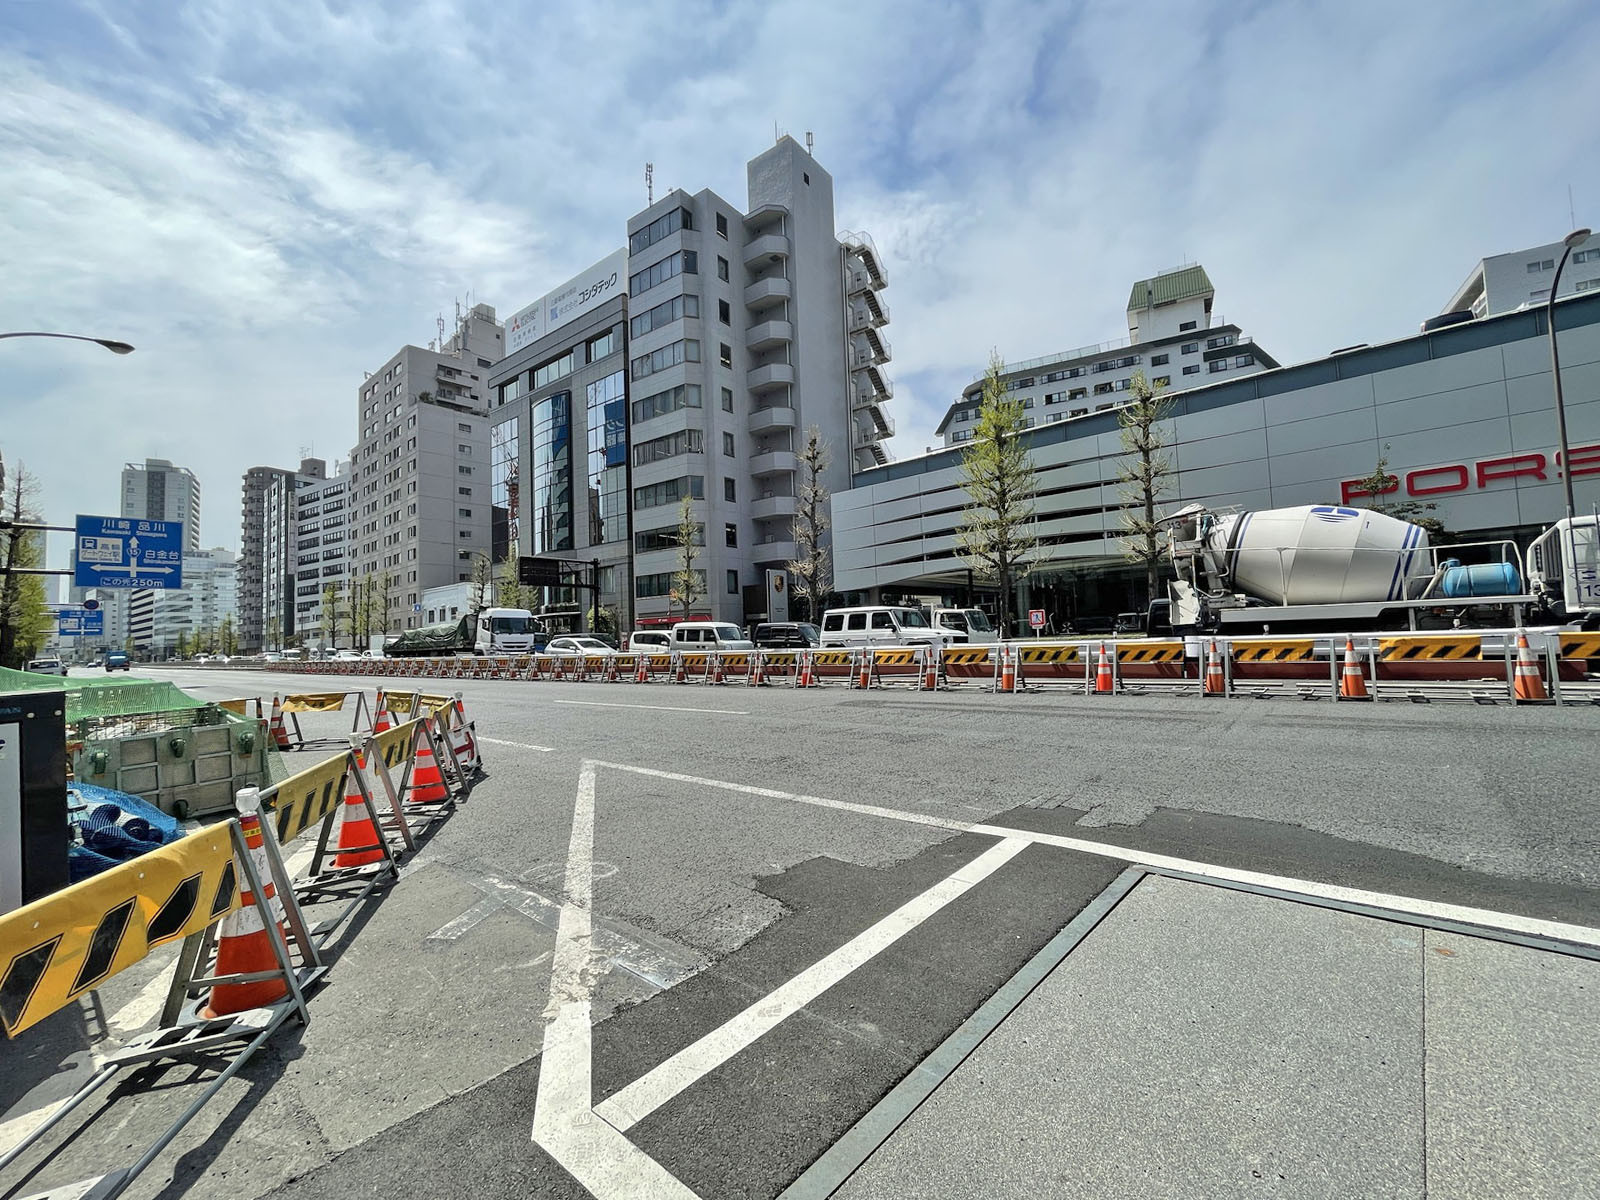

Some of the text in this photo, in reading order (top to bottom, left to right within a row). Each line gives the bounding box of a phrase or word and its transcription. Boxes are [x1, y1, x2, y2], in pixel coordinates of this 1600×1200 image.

[102, 519, 165, 532] 川崎 品川
[145, 549, 179, 560] 白金台
[103, 578, 163, 587] この先250m
